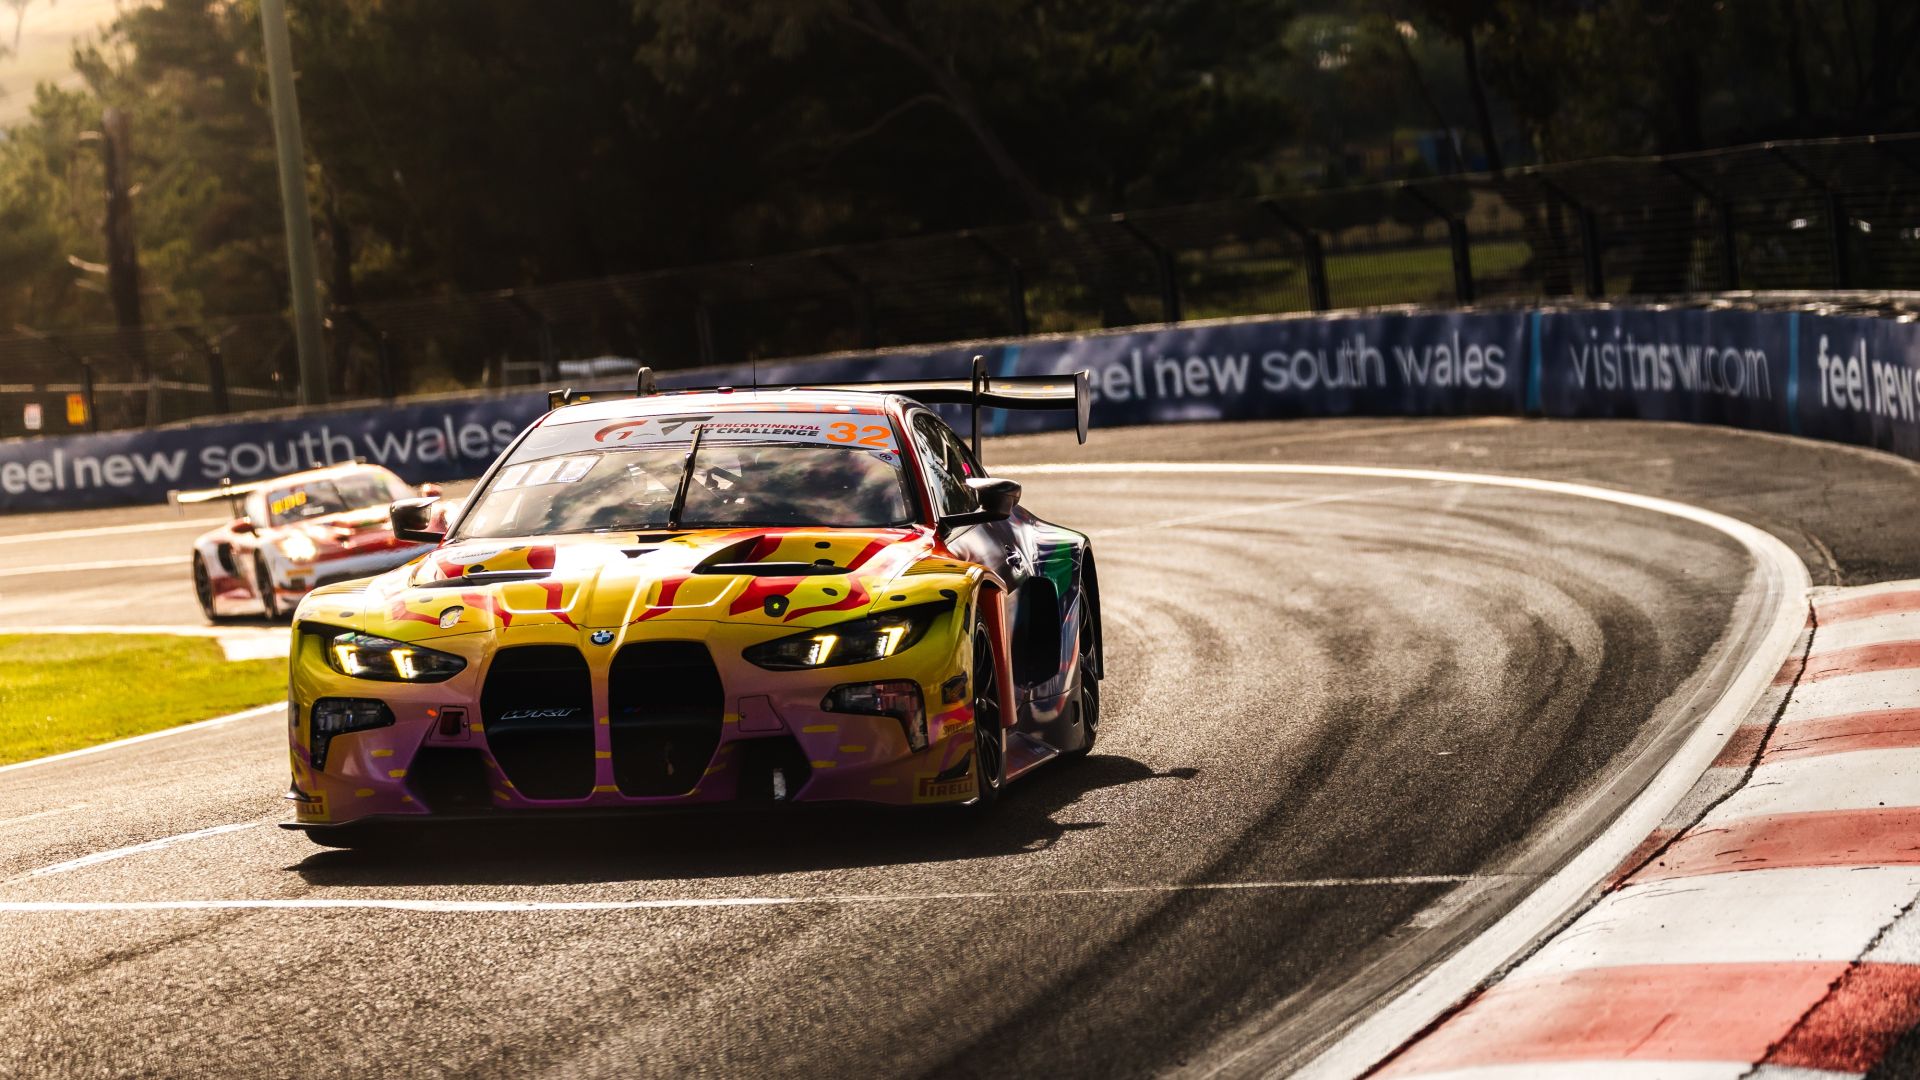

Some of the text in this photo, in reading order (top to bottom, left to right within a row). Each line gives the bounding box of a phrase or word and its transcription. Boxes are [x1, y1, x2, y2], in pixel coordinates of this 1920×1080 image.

[1154, 354, 1249, 398] new
[1261, 334, 1387, 392] south
[1395, 329, 1507, 389] wales
[1569, 326, 1773, 399] visitnsw.com
[1817, 333, 1871, 412] feel
[1871, 360, 1914, 423] new
[0, 414, 517, 494] eel new south wales
[694, 423, 822, 431] INTERCONTINENTAL
[716, 427, 820, 437] CHALLENGE
[825, 421, 892, 448] 32
